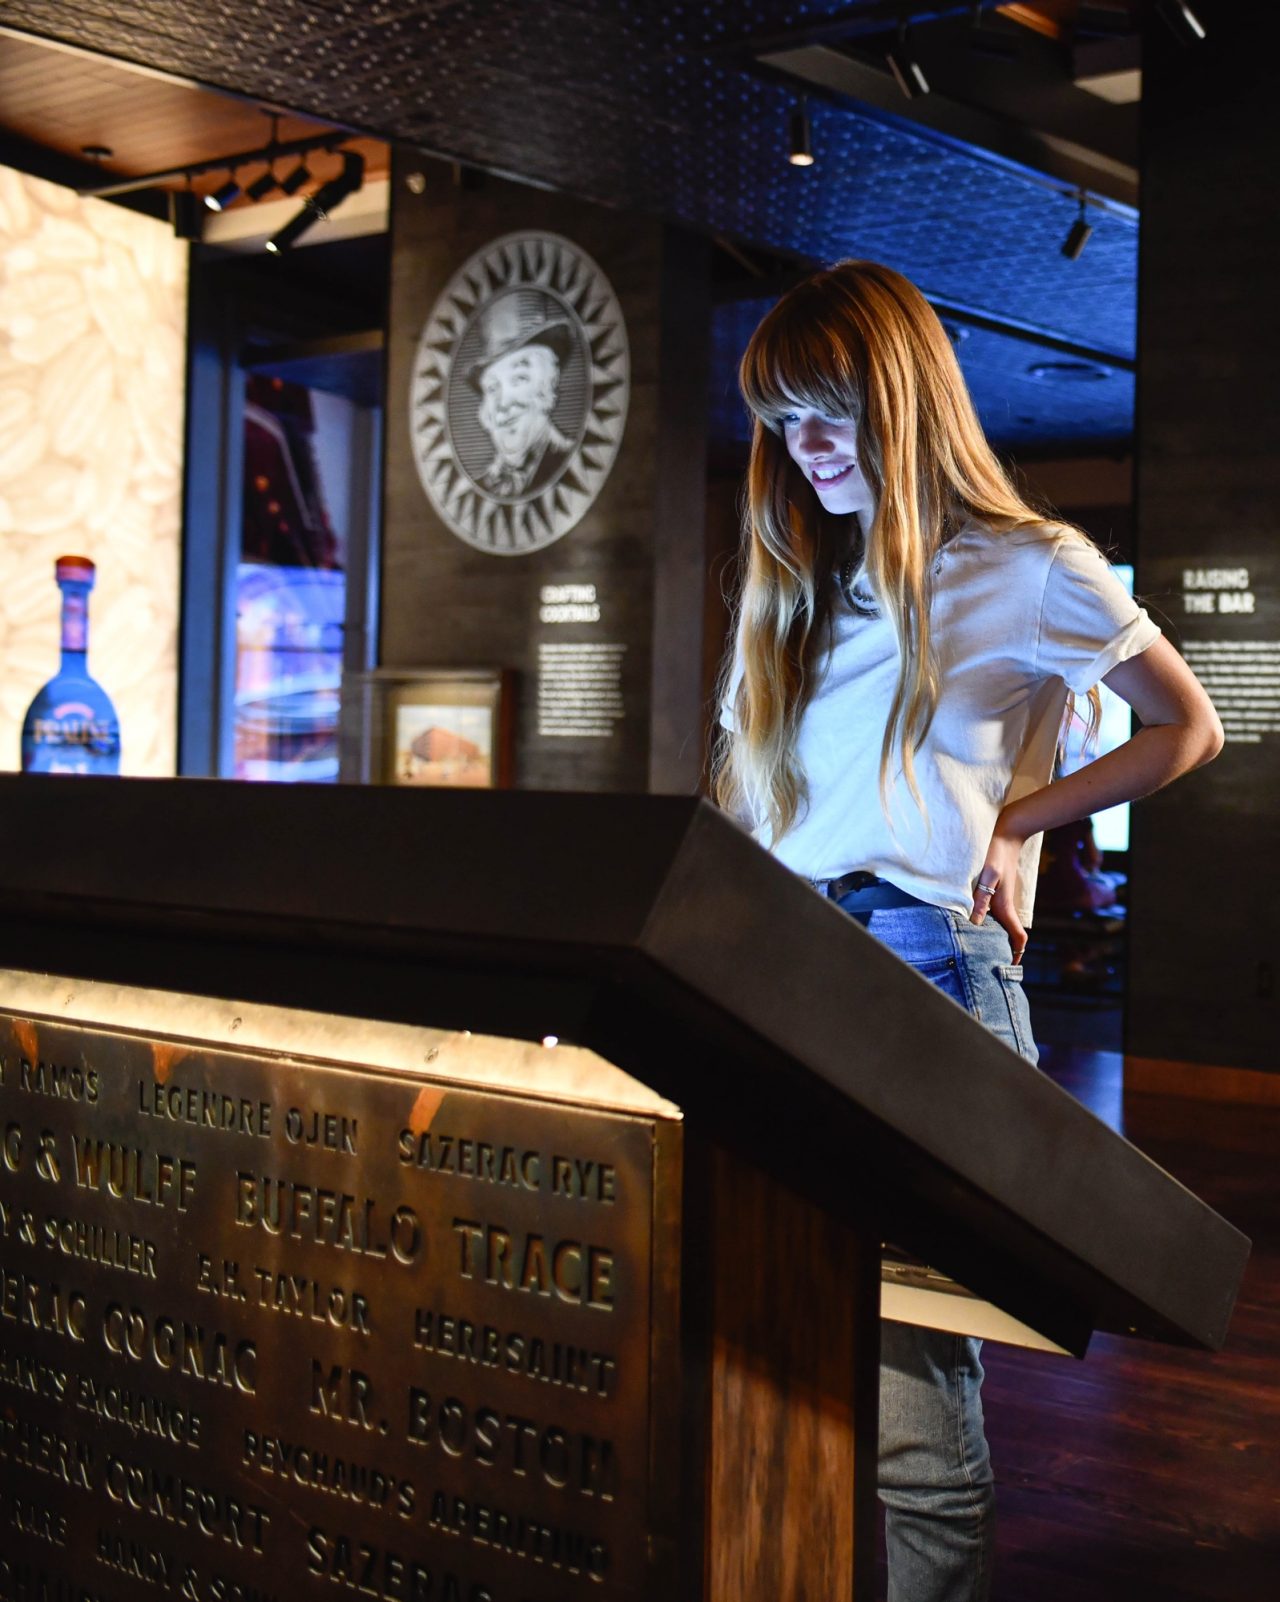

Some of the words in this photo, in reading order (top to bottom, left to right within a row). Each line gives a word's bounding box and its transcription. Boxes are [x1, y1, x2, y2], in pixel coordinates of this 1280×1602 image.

[1184, 592, 1215, 613] THE
[1219, 592, 1255, 613] BAR
[19, 1057, 98, 1104] RAMOS
[138, 1080, 272, 1139] LEGENDRE
[285, 1107, 358, 1156] OJEN
[36, 1128, 61, 1183] &
[71, 1135, 197, 1213] WULFF
[399, 1128, 540, 1192] SAZERAC
[552, 1155, 616, 1205] RYE
[19, 1209, 37, 1246] &
[44, 1215, 158, 1279] SCHILLER
[235, 1169, 421, 1266] BUFFALO
[452, 1216, 614, 1312] TRACE
[253, 1268, 370, 1336] TAYLOR
[104, 1302, 257, 1395] COGNAC
[414, 1308, 616, 1397] HERBSAINT
[76, 1373, 200, 1449] EXCHANGE
[309, 1358, 387, 1436] MR.
[407, 1385, 616, 1502] BOSTON
[105, 1452, 271, 1554] COMFORT
[243, 1428, 416, 1519] PEYCHAUD'S
